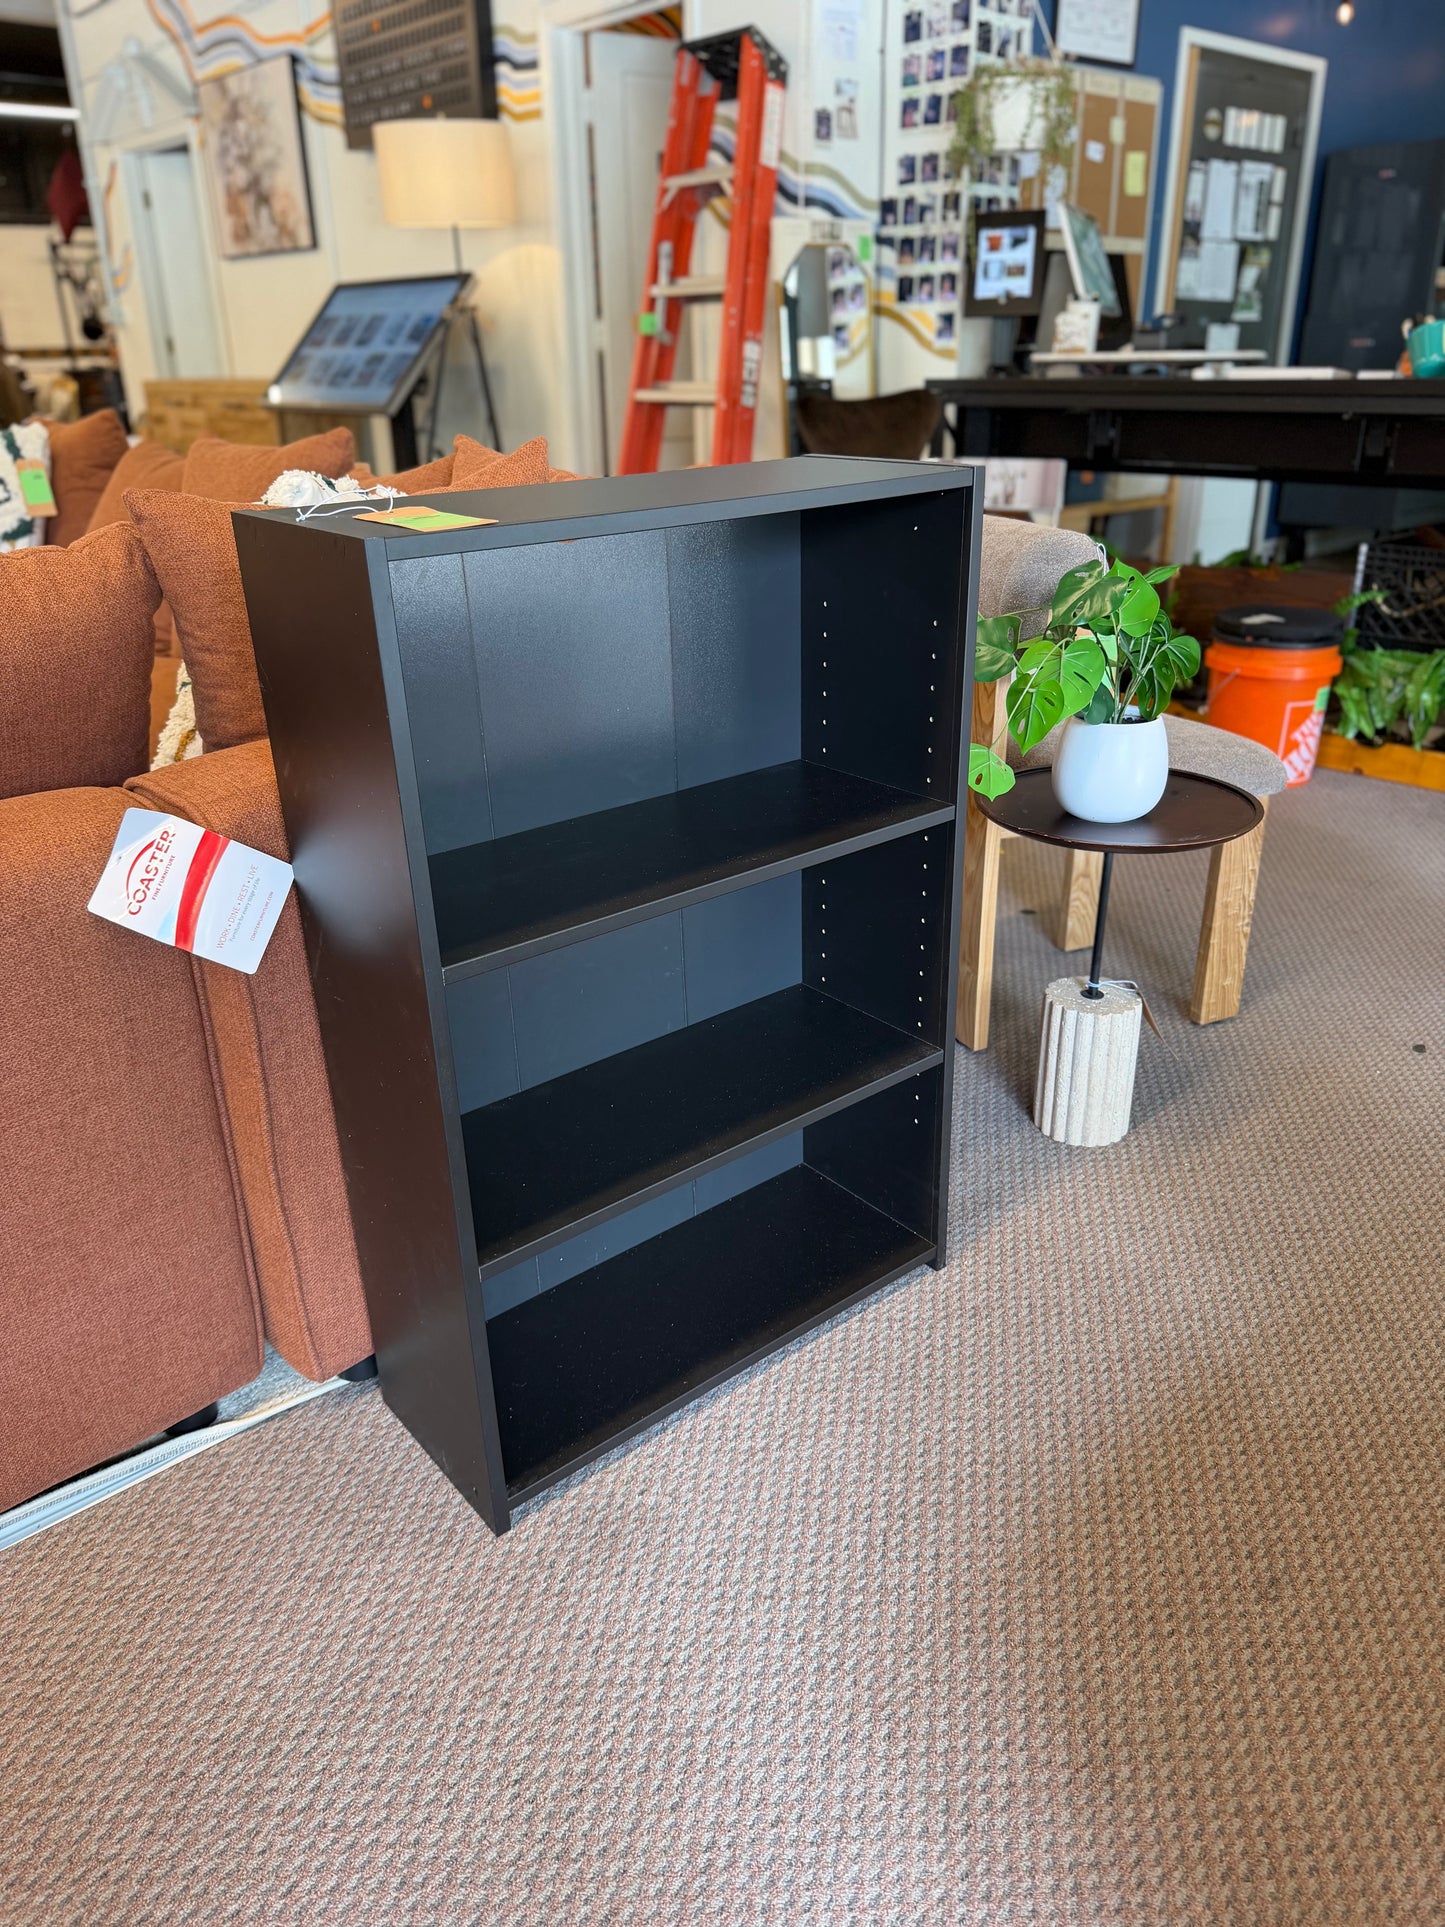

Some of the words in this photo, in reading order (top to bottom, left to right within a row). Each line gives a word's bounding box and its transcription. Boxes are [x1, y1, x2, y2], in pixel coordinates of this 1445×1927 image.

[127, 830, 176, 916] COASTER
[152, 884, 163, 901] FINE
[157, 854, 176, 887] FURNITURE
[216, 927, 231, 949] WORK
[227, 906, 241, 923] DINE
[237, 884, 250, 902] REST
[247, 864, 259, 880] LIVE
